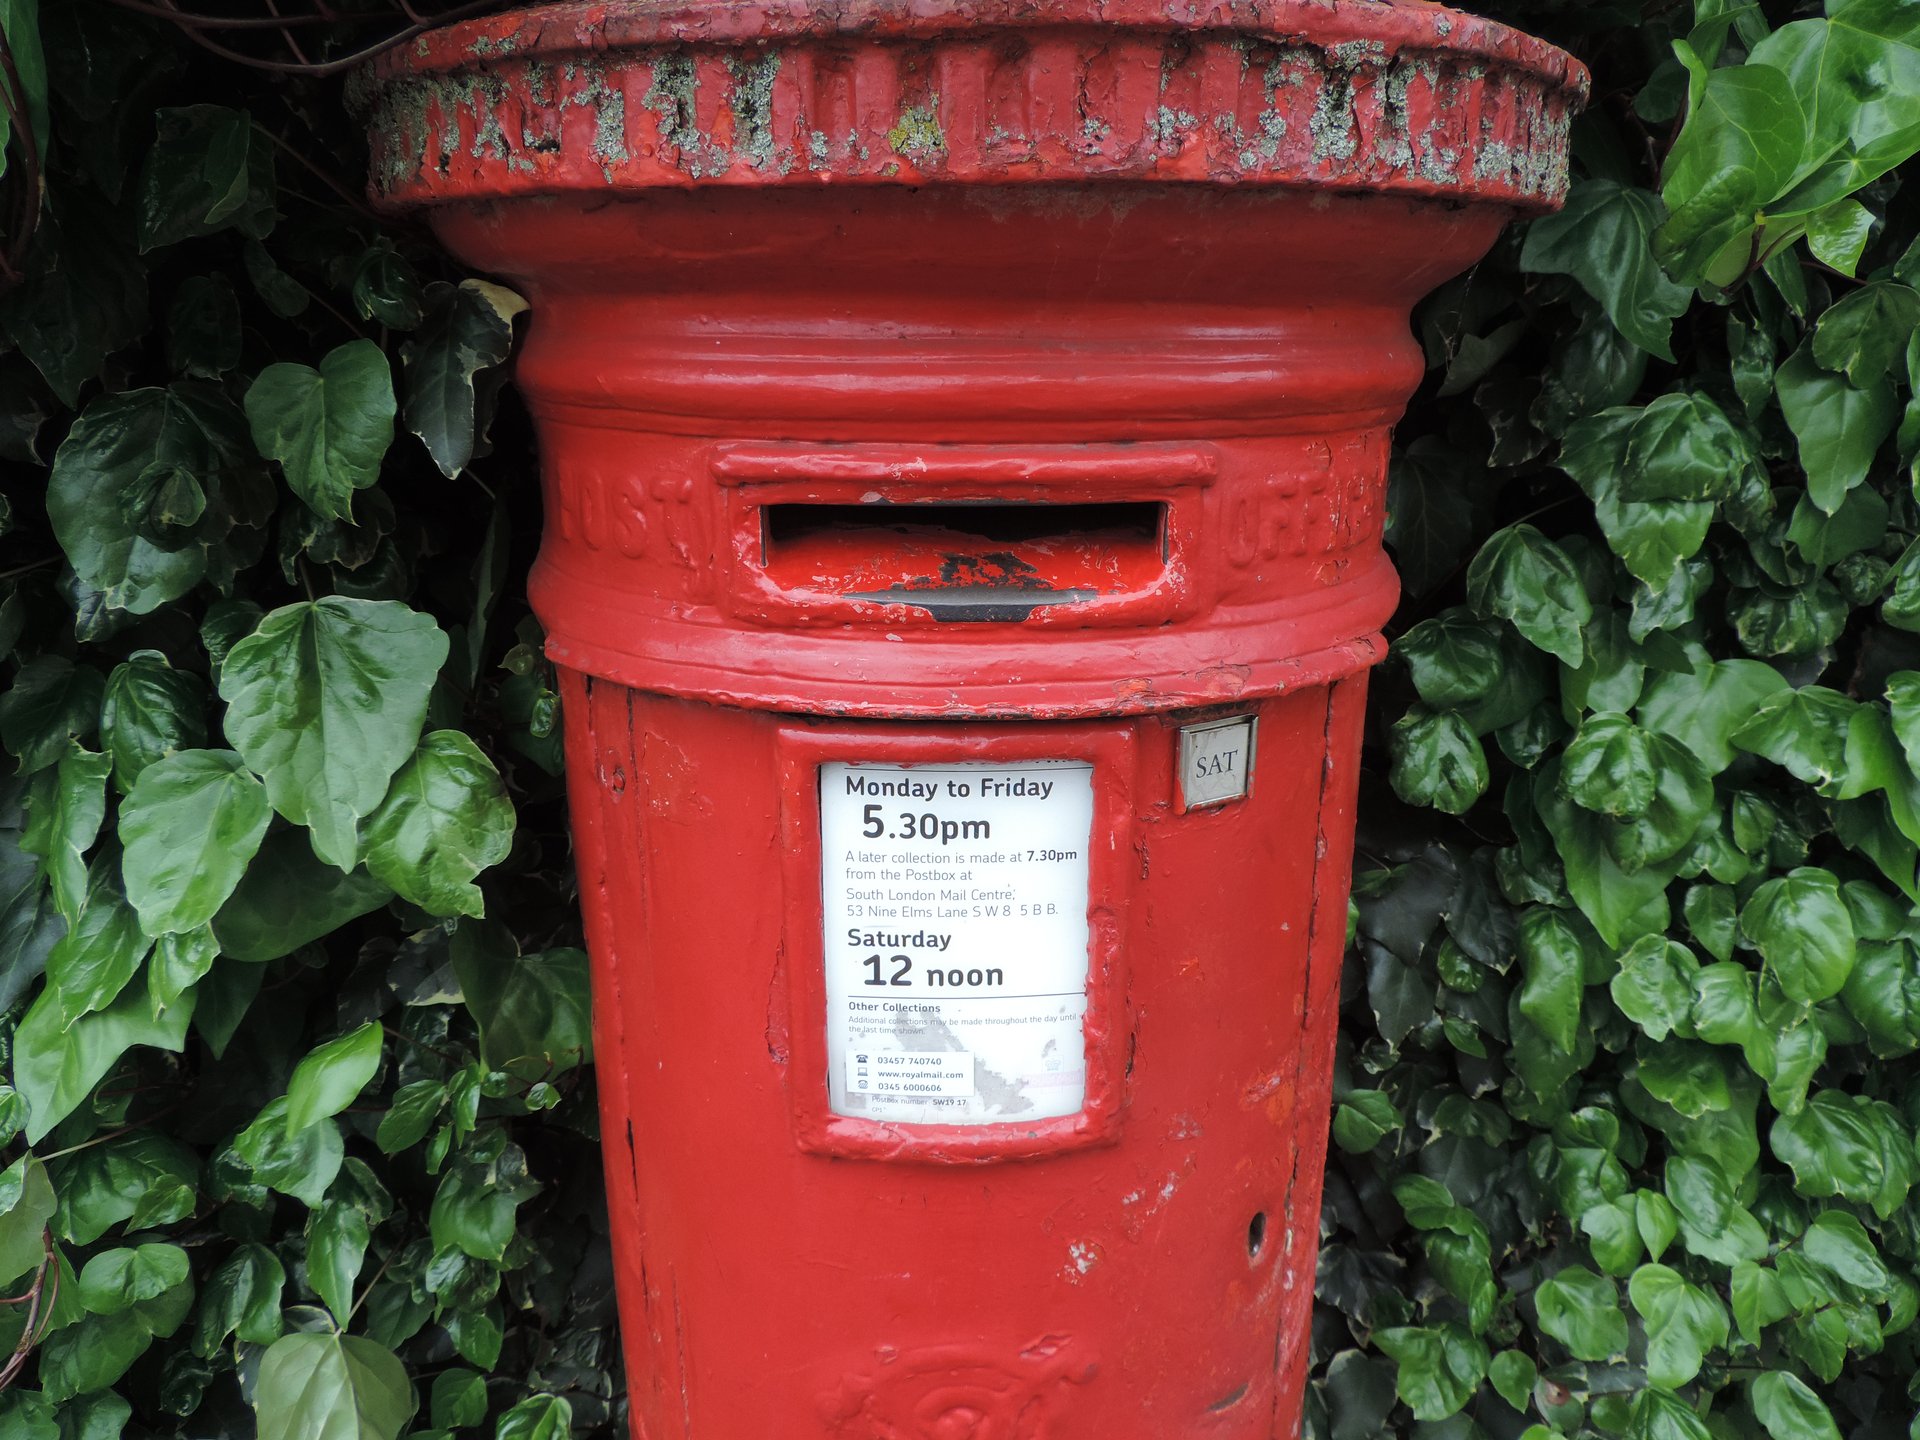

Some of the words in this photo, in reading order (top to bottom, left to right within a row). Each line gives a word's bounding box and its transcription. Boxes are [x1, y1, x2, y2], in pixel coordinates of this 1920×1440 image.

[1196, 749, 1238, 778] SAT
[846, 775, 938, 801] Monday
[947, 780, 970, 797] to
[981, 777, 1053, 800] Friday
[863, 804, 990, 845] 5.30pm
[845, 850, 854, 862] A
[858, 851, 887, 863] later
[892, 852, 950, 864] collection
[955, 852, 965, 863] is
[970, 852, 1005, 863] made
[1010, 852, 1022, 862] at
[1027, 849, 1077, 862] 7.30pm
[846, 868, 875, 879] from
[881, 868, 900, 880] the
[906, 868, 956, 880] Postbox
[960, 870, 972, 880] at
[846, 888, 883, 900] South
[889, 889, 935, 901] London
[940, 889, 966, 901] Mail
[847, 905, 863, 916] 53
[868, 905, 897, 917] Nine
[902, 905, 932, 917] Elms
[937, 906, 968, 917] Lane
[847, 928, 952, 951] Saturday
[863, 954, 912, 986] 12
[926, 968, 1003, 986] noon
[848, 1001, 879, 1011] Other
[882, 1002, 941, 1012] Collections
[848, 1016, 886, 1024] Additional
[888, 1016, 928, 1025] collections
[930, 1018, 947, 1027] may
[949, 1017, 959, 1025] be
[961, 1017, 982, 1025] made
[985, 1016, 1027, 1026] throughout
[1030, 1015, 1042, 1024] the
[1044, 1015, 1058, 1023] day
[1059, 1013, 1077, 1022] until
[848, 1025, 861, 1033] the
[863, 1026, 877, 1034] last
[879, 1026, 896, 1034] time
[898, 1027, 925, 1035] shown.
[877, 1056, 905, 1065] 03457
[908, 1057, 942, 1065] 740740
[877, 1071, 964, 1079] www.royalmail.com
[878, 1082, 900, 1091] 0345
[903, 1083, 942, 1092] 6000606
[872, 1095, 898, 1104] Postbox
